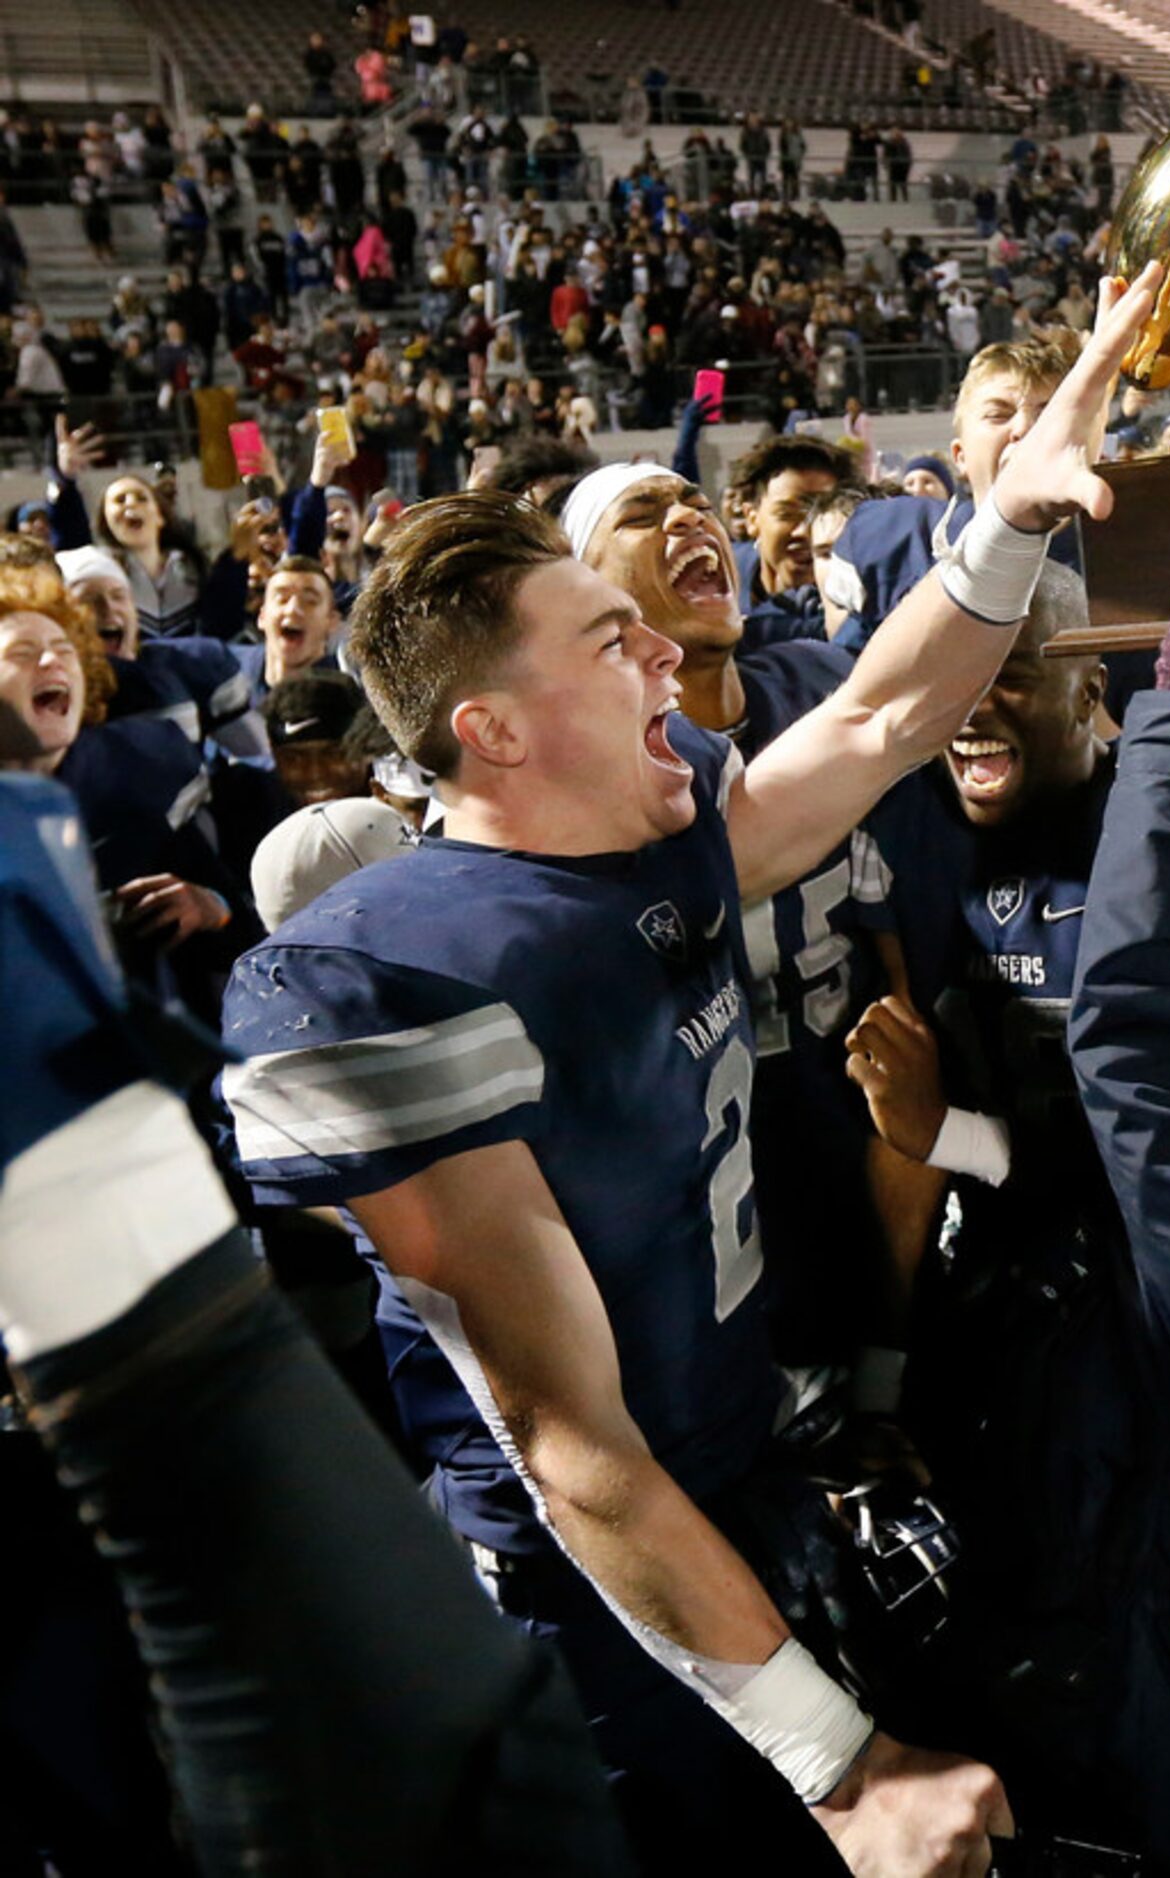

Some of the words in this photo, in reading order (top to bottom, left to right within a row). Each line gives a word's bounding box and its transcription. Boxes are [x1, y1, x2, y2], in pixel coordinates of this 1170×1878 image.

[741, 857, 853, 1057] 15
[968, 952, 1045, 986] NGERS
[701, 1035, 763, 1323] 2
